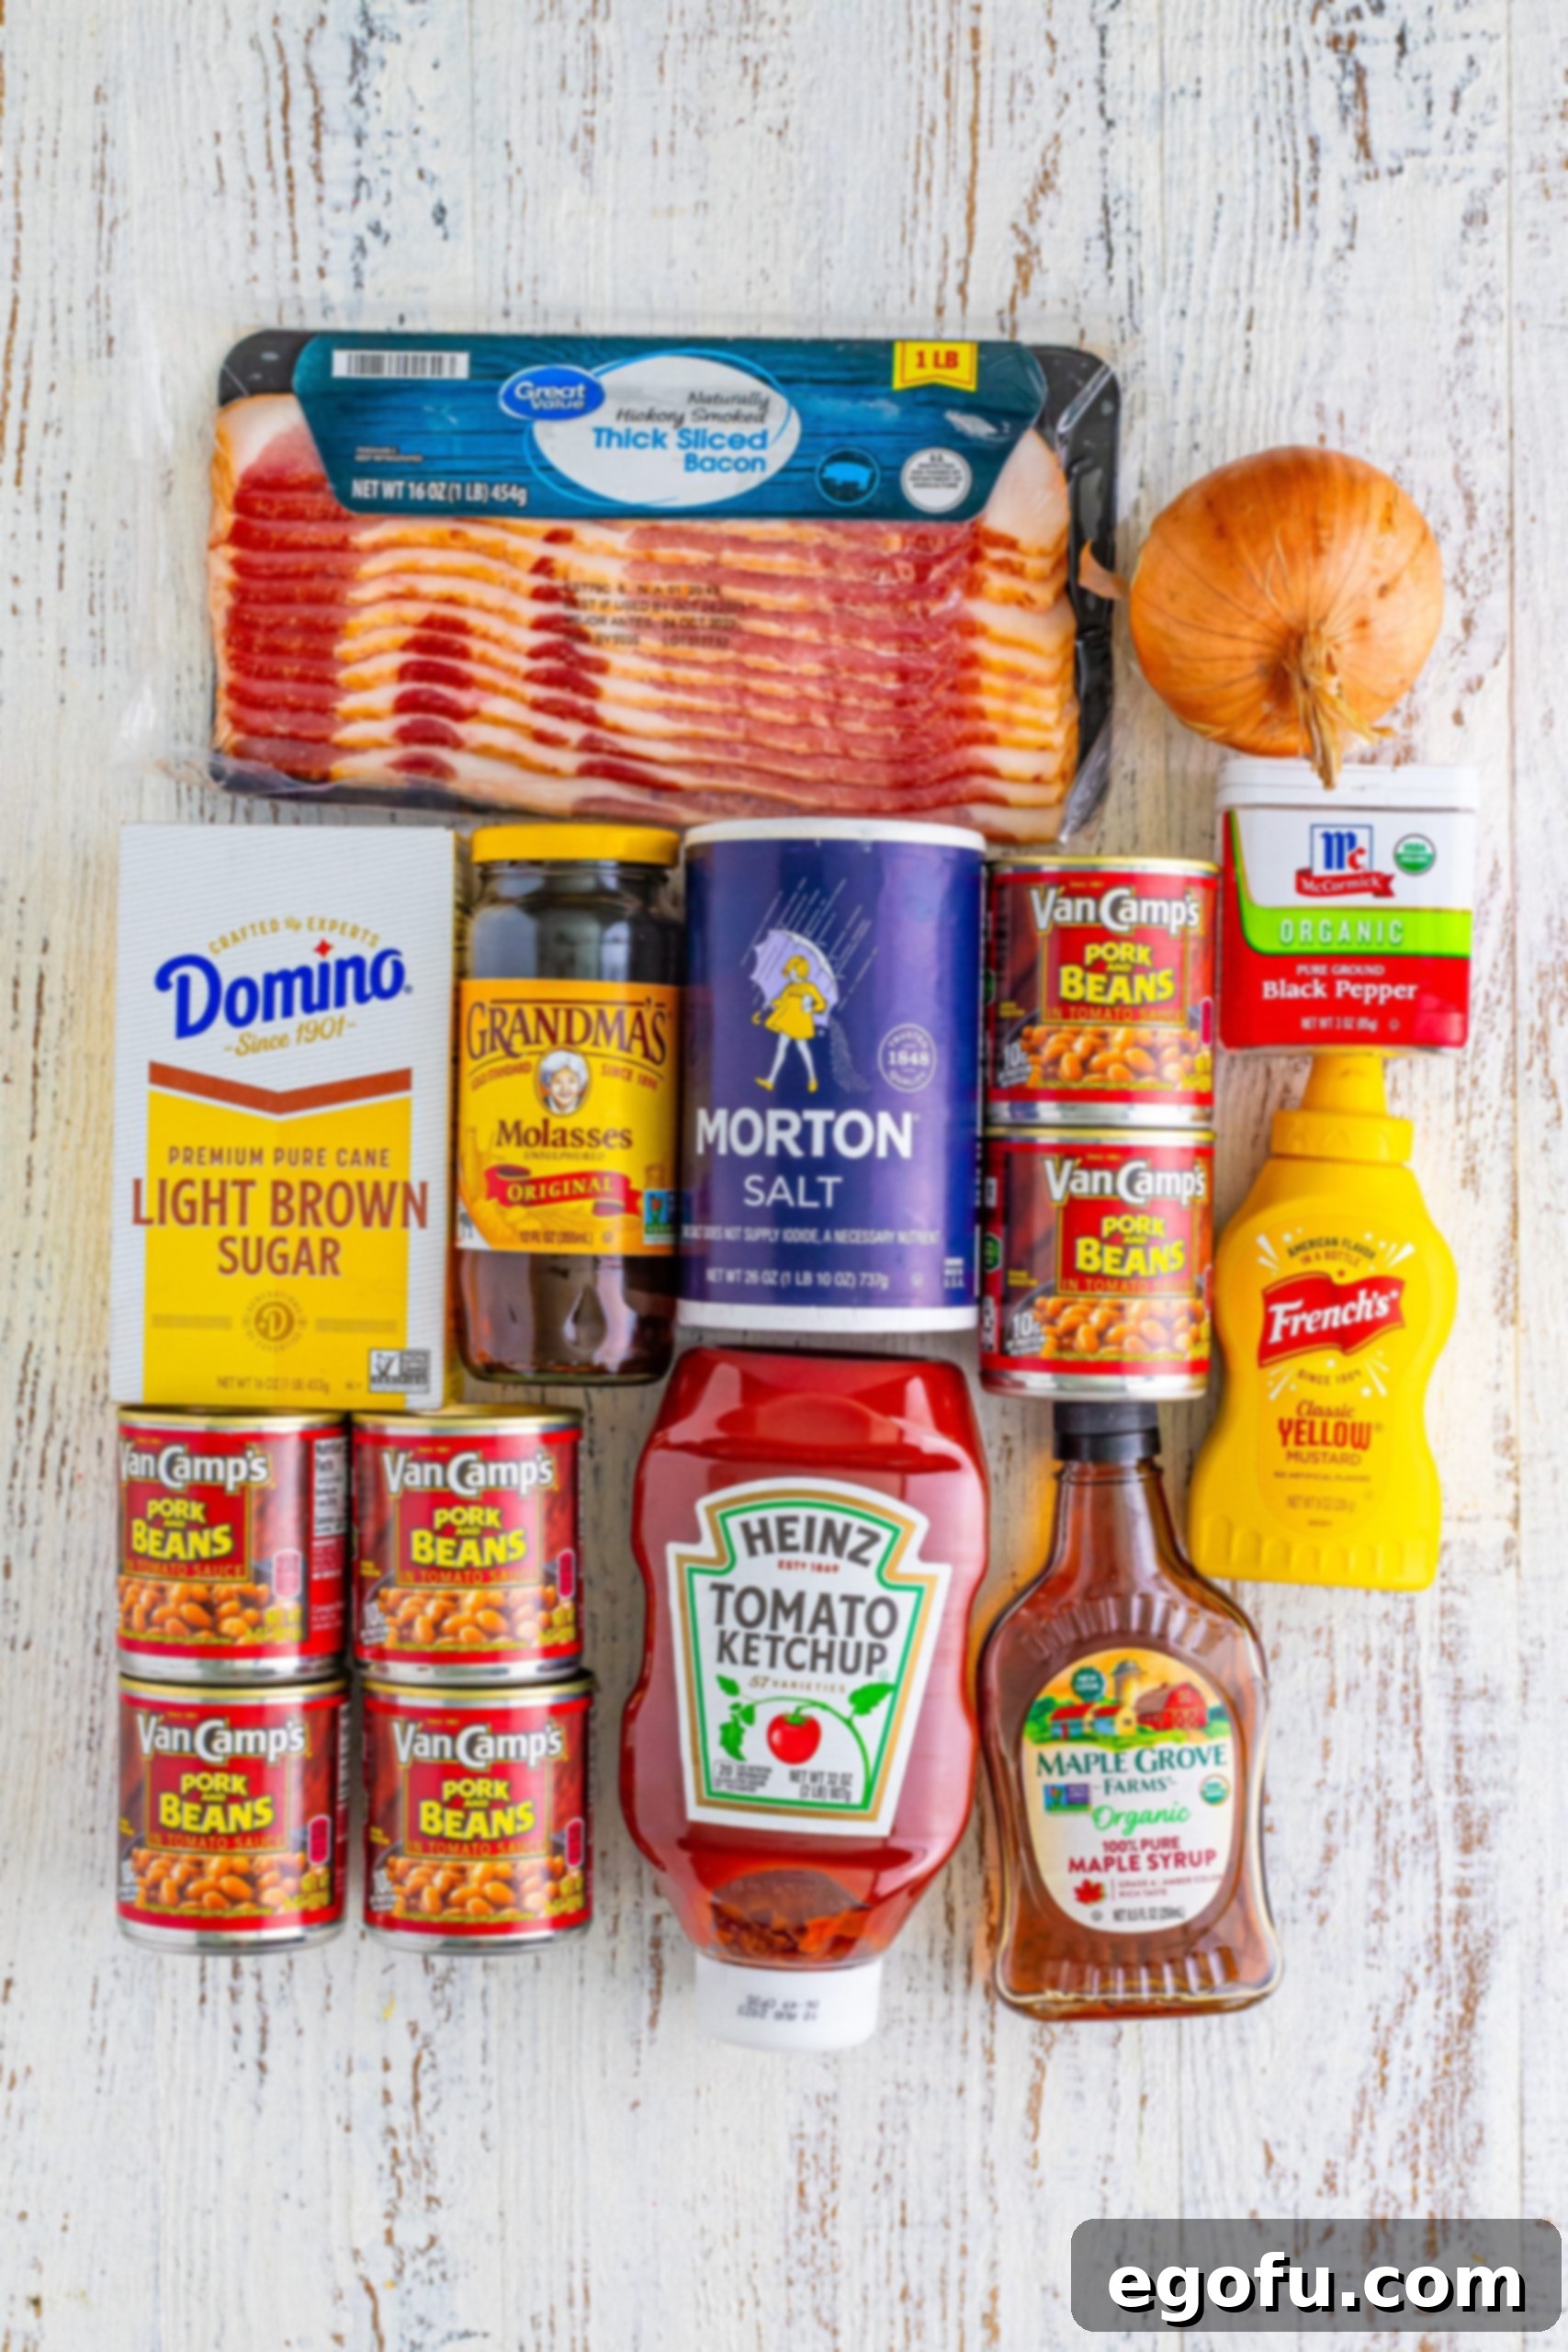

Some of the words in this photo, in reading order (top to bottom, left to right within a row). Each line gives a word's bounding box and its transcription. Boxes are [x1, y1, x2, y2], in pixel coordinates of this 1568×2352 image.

[917, 350, 927, 369] 1
[933, 350, 960, 369] LB
[513, 380, 586, 401] Great
[530, 394, 585, 411] Value
[687, 390, 771, 412] Naturally
[615, 407, 686, 428] Hickory
[692, 407, 766, 424] Smoked
[592, 426, 668, 449] Thick
[677, 427, 769, 451] Sliced
[683, 452, 767, 473] Bacon
[352, 479, 378, 498] NET
[381, 480, 404, 498] WT
[408, 481, 425, 500] 16
[427, 481, 446, 500] OZ
[465, 483, 489, 503] LB)
[491, 483, 528, 507] 454g
[1301, 876, 1381, 894] McCormick
[208, 918, 280, 955] CRAFTED
[307, 917, 380, 948] EXPERTS
[1280, 919, 1404, 945] ORGANIC
[1085, 942, 1152, 967] PORK
[1296, 964, 1327, 976] PURE
[1331, 964, 1385, 976] GROUND
[154, 948, 406, 1039] Domino
[1059, 965, 1176, 1004] BEANS
[1262, 978, 1327, 1000] Black
[1335, 978, 1417, 1005] Pepper
[1068, 1007, 1134, 1021] TOMATO
[1301, 1016, 1317, 1030] NET
[467, 996, 668, 1066] GRANDMA'S
[496, 1118, 634, 1149] Molasses
[696, 1107, 913, 1159] MORTON
[168, 1146, 265, 1167] PREMIUM
[273, 1147, 327, 1167] PURE
[336, 1148, 390, 1169] CANE
[507, 1176, 615, 1202] ORIGINAL
[743, 1174, 843, 1208] SALT
[131, 1178, 256, 1227] LIGHT
[270, 1180, 429, 1229] BROWN
[743, 1227, 780, 1242] SUPPLY
[834, 1229, 896, 1244] NECESSARY
[1101, 1215, 1166, 1238] PORK
[218, 1235, 342, 1277] SUGAR
[1075, 1237, 1185, 1278] BEANS
[1287, 1237, 1339, 1258] AMERICAN
[1341, 1238, 1376, 1260] FLAVOR
[1325, 1250, 1360, 1267] BOTTLE
[705, 1268, 724, 1283] NET
[726, 1269, 742, 1283] WT
[761, 1270, 778, 1284] OZ
[795, 1272, 813, 1285] LB
[817, 1272, 831, 1286] 10
[1268, 1288, 1390, 1345] French's
[1297, 1368, 1331, 1385] SINCE
[1296, 1398, 1355, 1419] Classic
[1278, 1418, 1372, 1452] YELLOW
[1286, 1450, 1362, 1466] MUSTARD
[147, 1498, 206, 1522] PORK
[434, 1506, 502, 1529] PORK
[131, 1518, 233, 1560] BEANS
[411, 1529, 526, 1568] BEANS
[739, 1514, 882, 1567] HEINZ
[193, 1564, 244, 1577] SAUCE
[421, 1569, 483, 1584] TOMATO
[810, 1560, 840, 1574] 1869
[709, 1582, 899, 1640] TOMATO
[716, 1630, 889, 1677] KETCHUP
[748, 1674, 770, 1689] 57
[772, 1679, 847, 1694] VARIETIES
[1036, 1749, 1128, 1777] MAPLE
[1134, 1745, 1227, 1773] GROVE
[180, 1771, 248, 1796] PORK
[789, 1770, 808, 1784] NET
[808, 1770, 826, 1785] WT
[1104, 1778, 1167, 1795] FARMS
[442, 1779, 510, 1802] PORK
[159, 1792, 275, 1834] BEANS
[419, 1800, 535, 1840] BEANS
[1090, 1802, 1190, 1837] Organic
[427, 1841, 491, 1857] TOMATO
[1102, 1839, 1139, 1853] 100%
[1141, 1837, 1180, 1851] PURE
[1068, 1855, 1140, 1873] MAPLE
[1147, 1849, 1217, 1871] SYRUP
